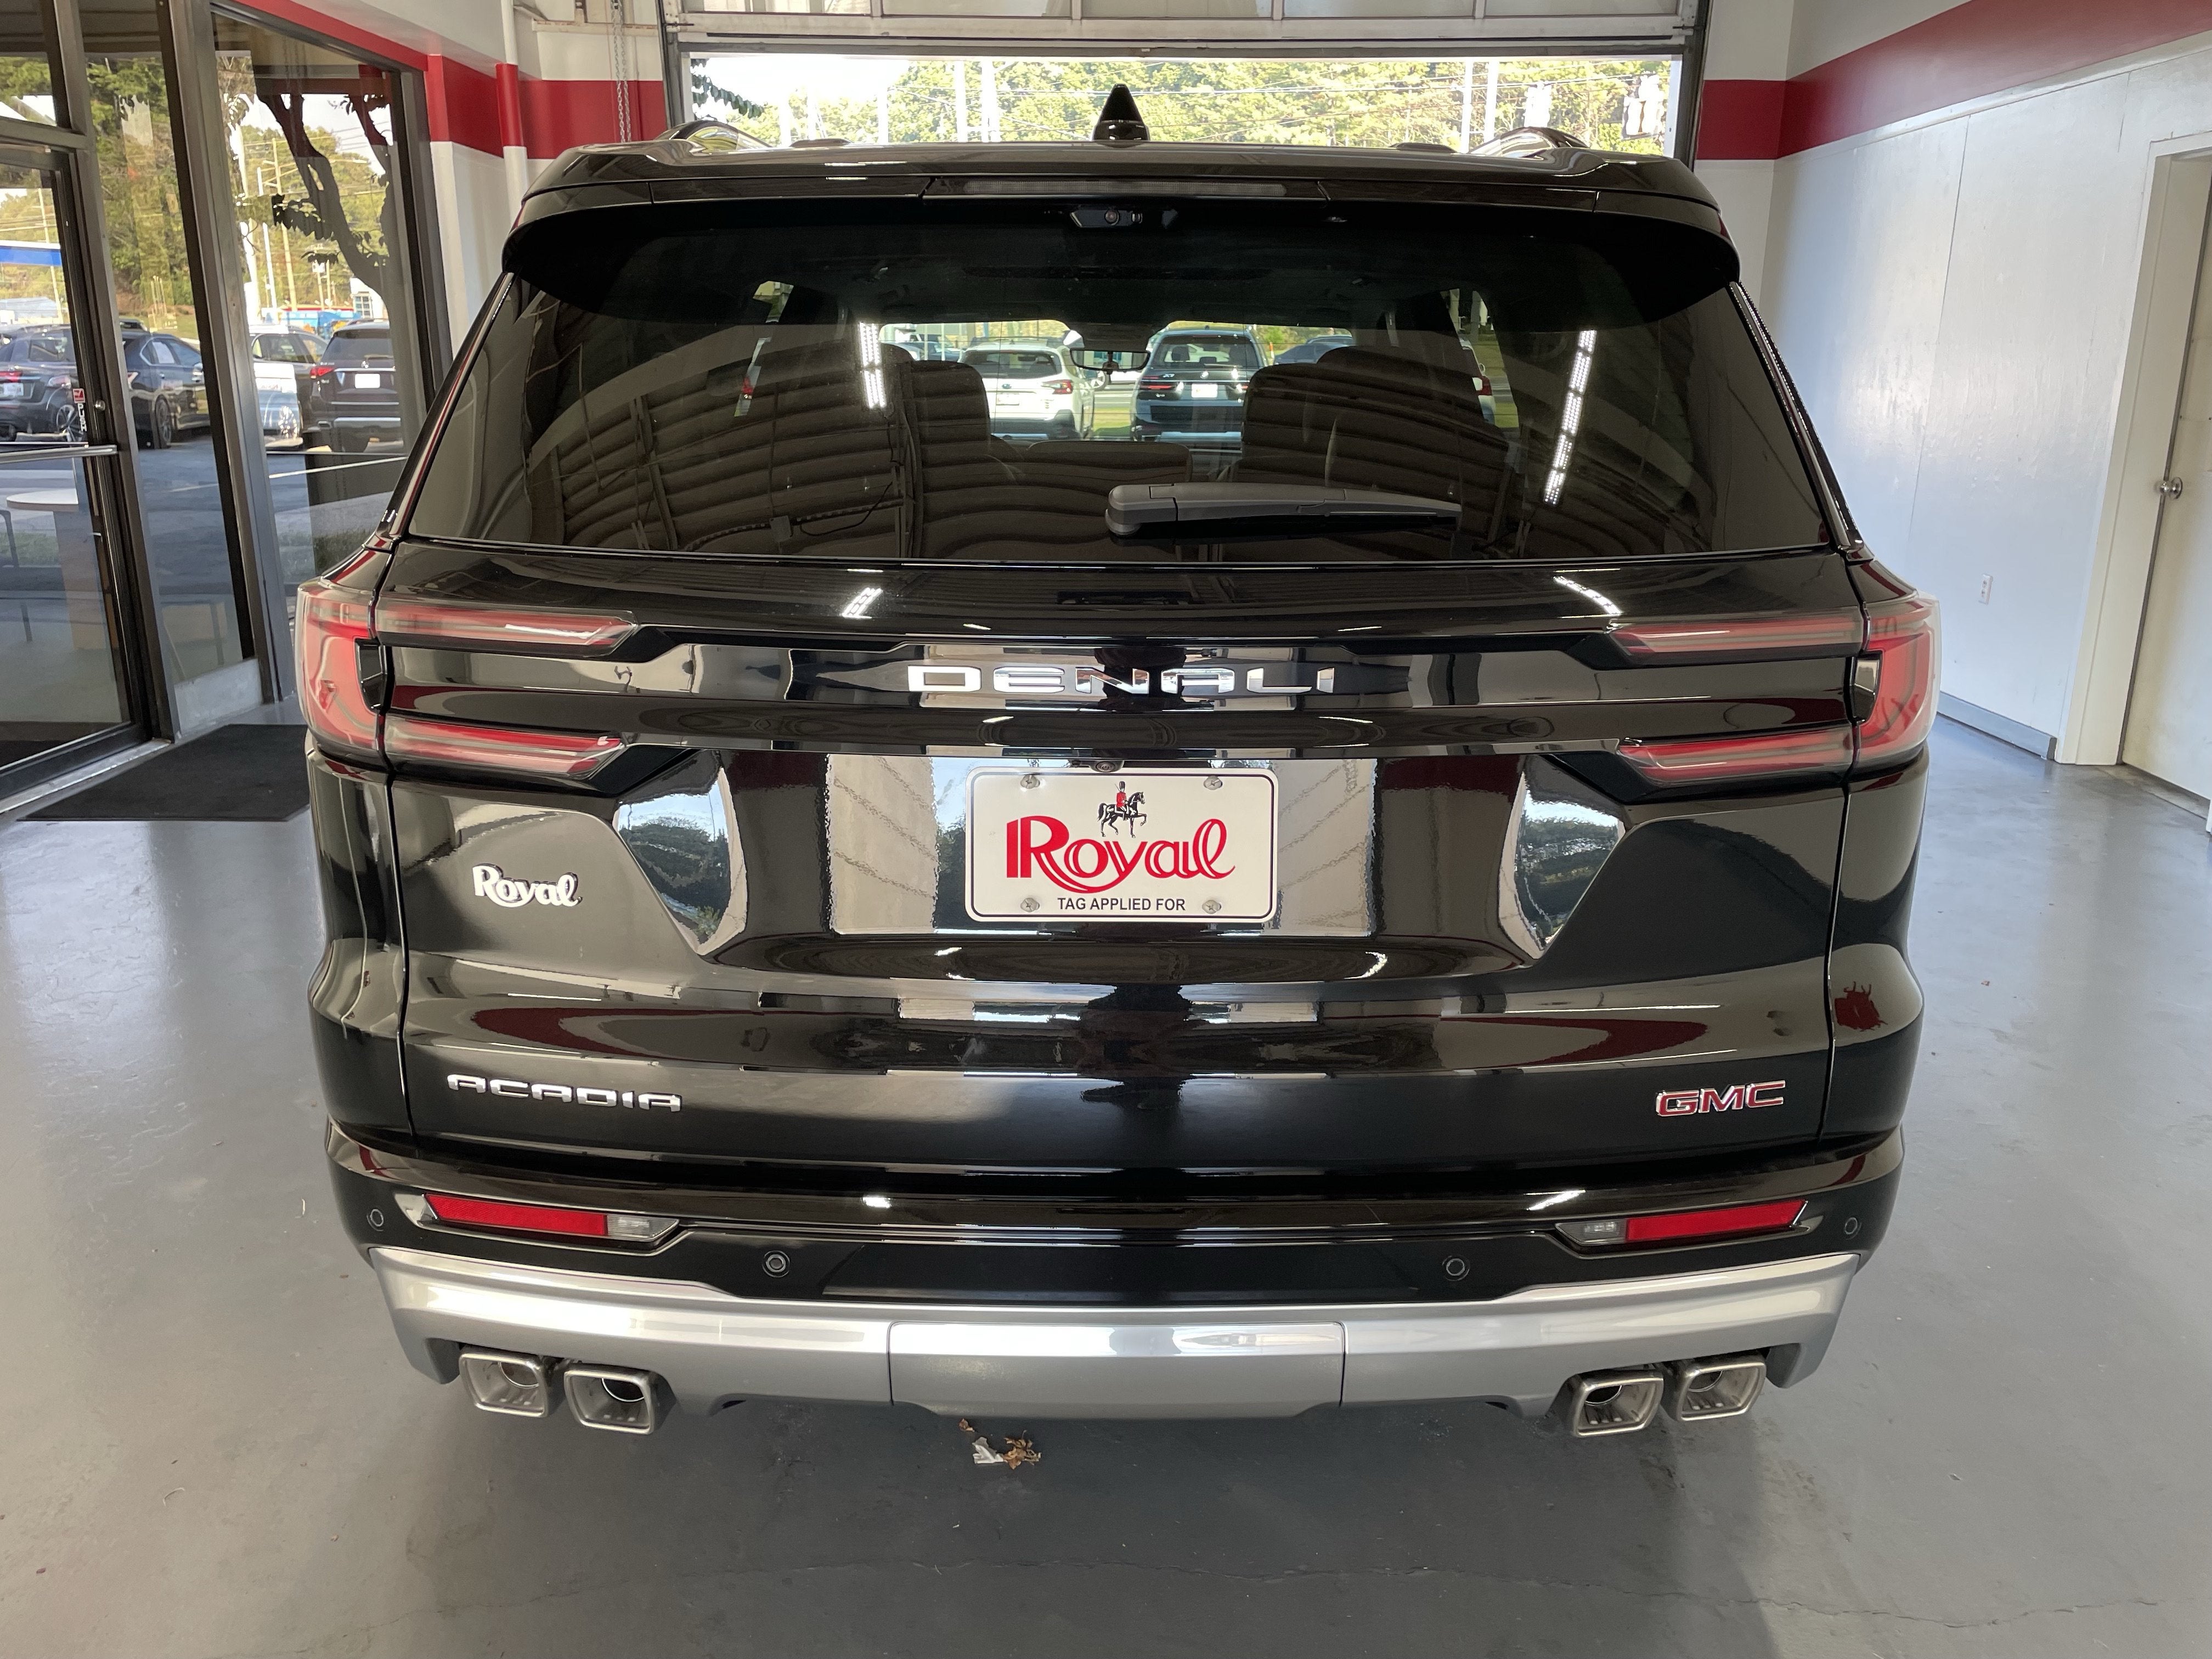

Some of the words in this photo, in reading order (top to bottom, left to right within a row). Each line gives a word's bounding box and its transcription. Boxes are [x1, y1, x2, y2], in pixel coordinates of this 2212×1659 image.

[77, 403, 87, 432] PUSH
[907, 665, 1335, 694] DENALI
[1006, 815, 1235, 894] Royal
[472, 863, 583, 908] Royal
[1057, 898, 1086, 910] TAG
[1090, 898, 1151, 911] APPLIED
[1156, 898, 1186, 911] FOR
[447, 1074, 682, 1113] ACADIA
[1655, 1080, 1786, 1117] GMC
